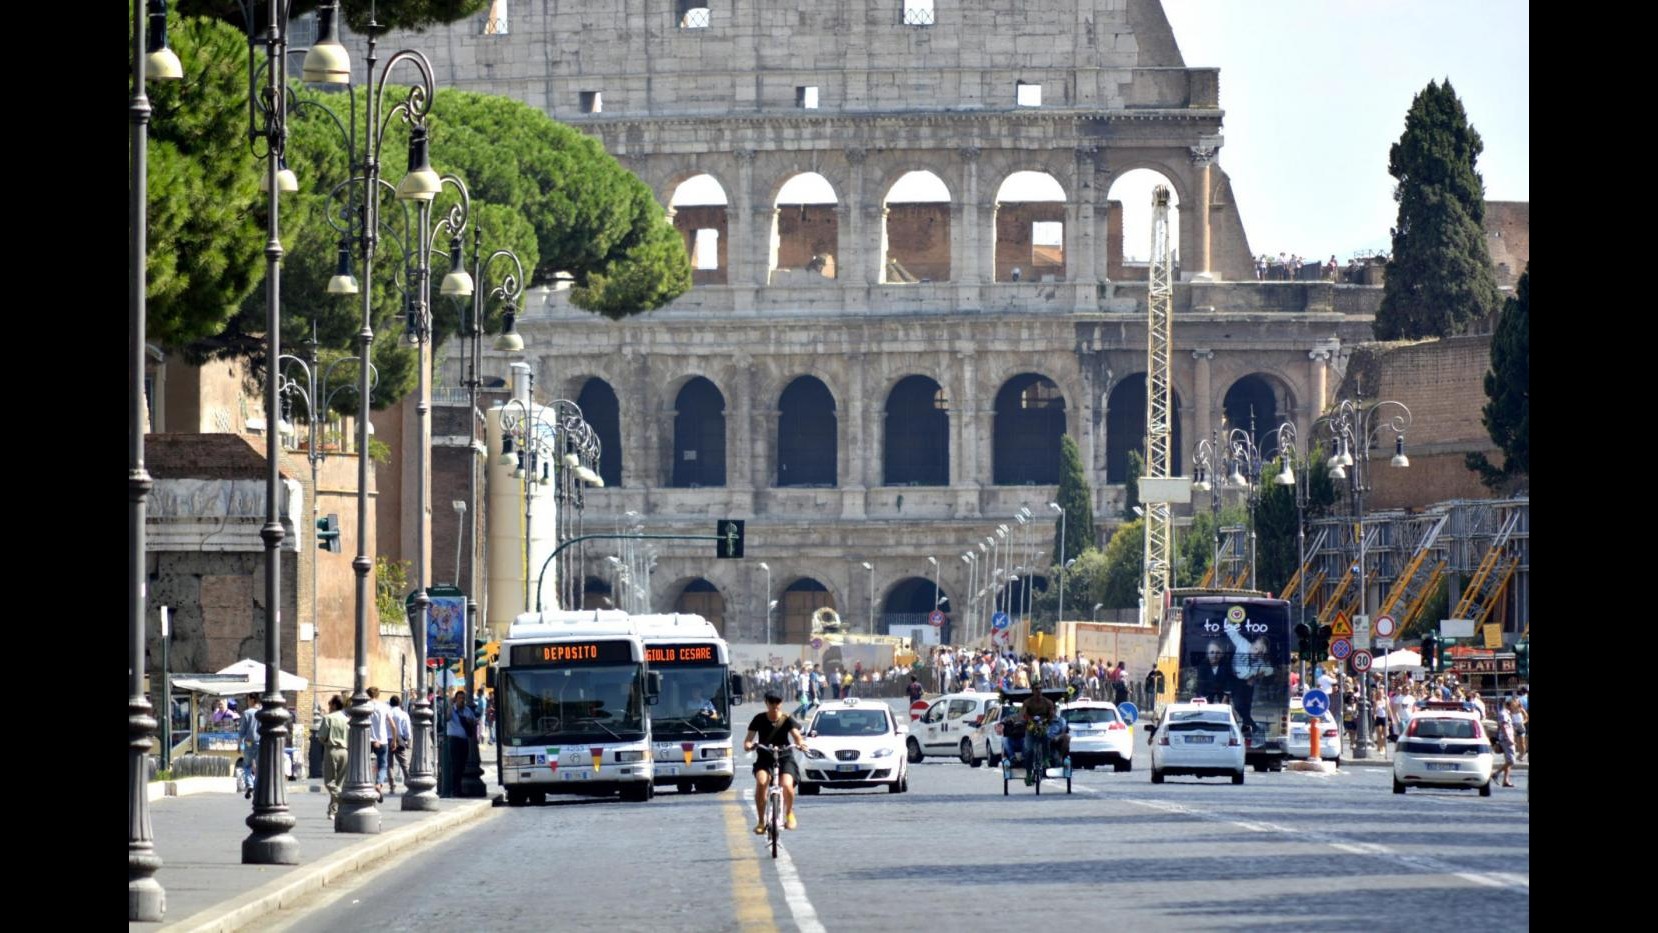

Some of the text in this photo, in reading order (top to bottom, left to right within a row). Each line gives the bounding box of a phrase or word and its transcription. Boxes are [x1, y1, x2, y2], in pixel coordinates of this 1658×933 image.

[1203, 617, 1269, 633] to be too
[544, 645, 597, 660] DEPOSITO
[646, 647, 712, 662] GIULIO CESARE
[1356, 655, 1369, 667] 30
